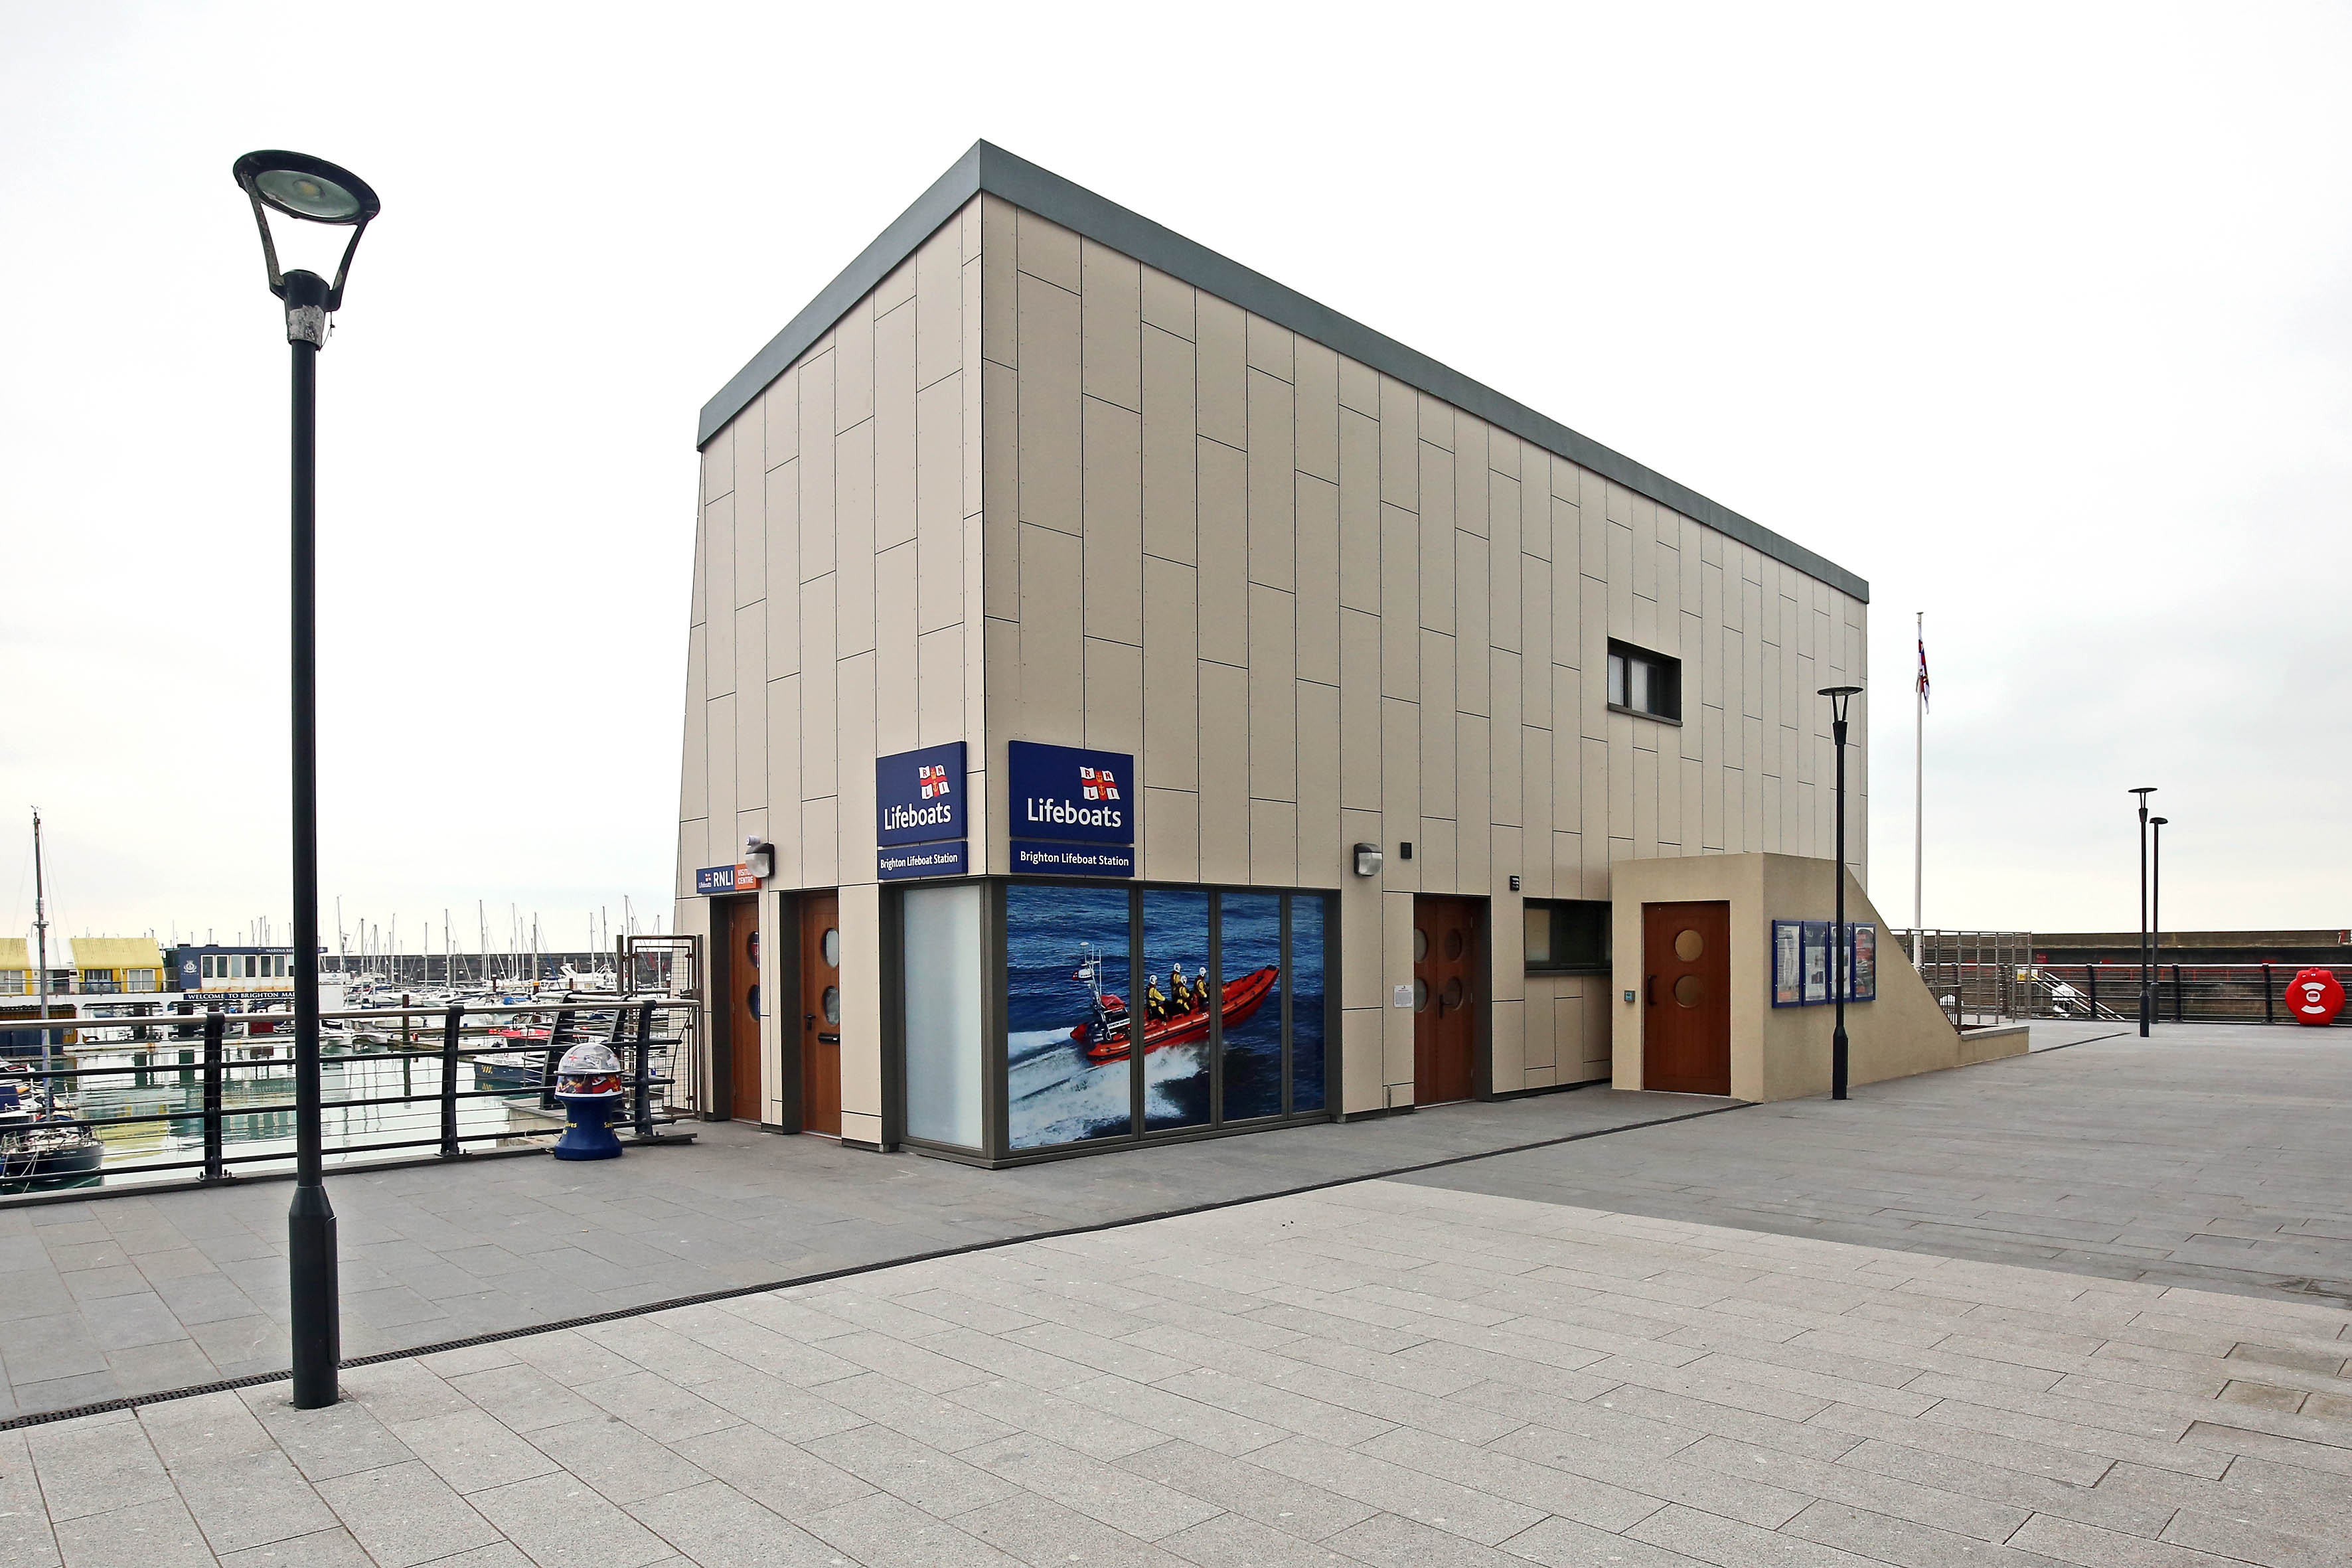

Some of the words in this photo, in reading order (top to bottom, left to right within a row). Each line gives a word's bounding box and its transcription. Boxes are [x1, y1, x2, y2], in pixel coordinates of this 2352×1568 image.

[884, 802, 951, 830] Lifeboats
[1028, 798, 1122, 827] Lifeboats
[880, 858, 906, 871] Brighton
[907, 855, 933, 866] Lifeboat
[933, 852, 958, 864] Station
[1020, 850, 1059, 864] Brighton
[1061, 853, 1097, 864] Lifeboat
[1099, 855, 1129, 866] Station
[713, 870, 734, 887] RNLI
